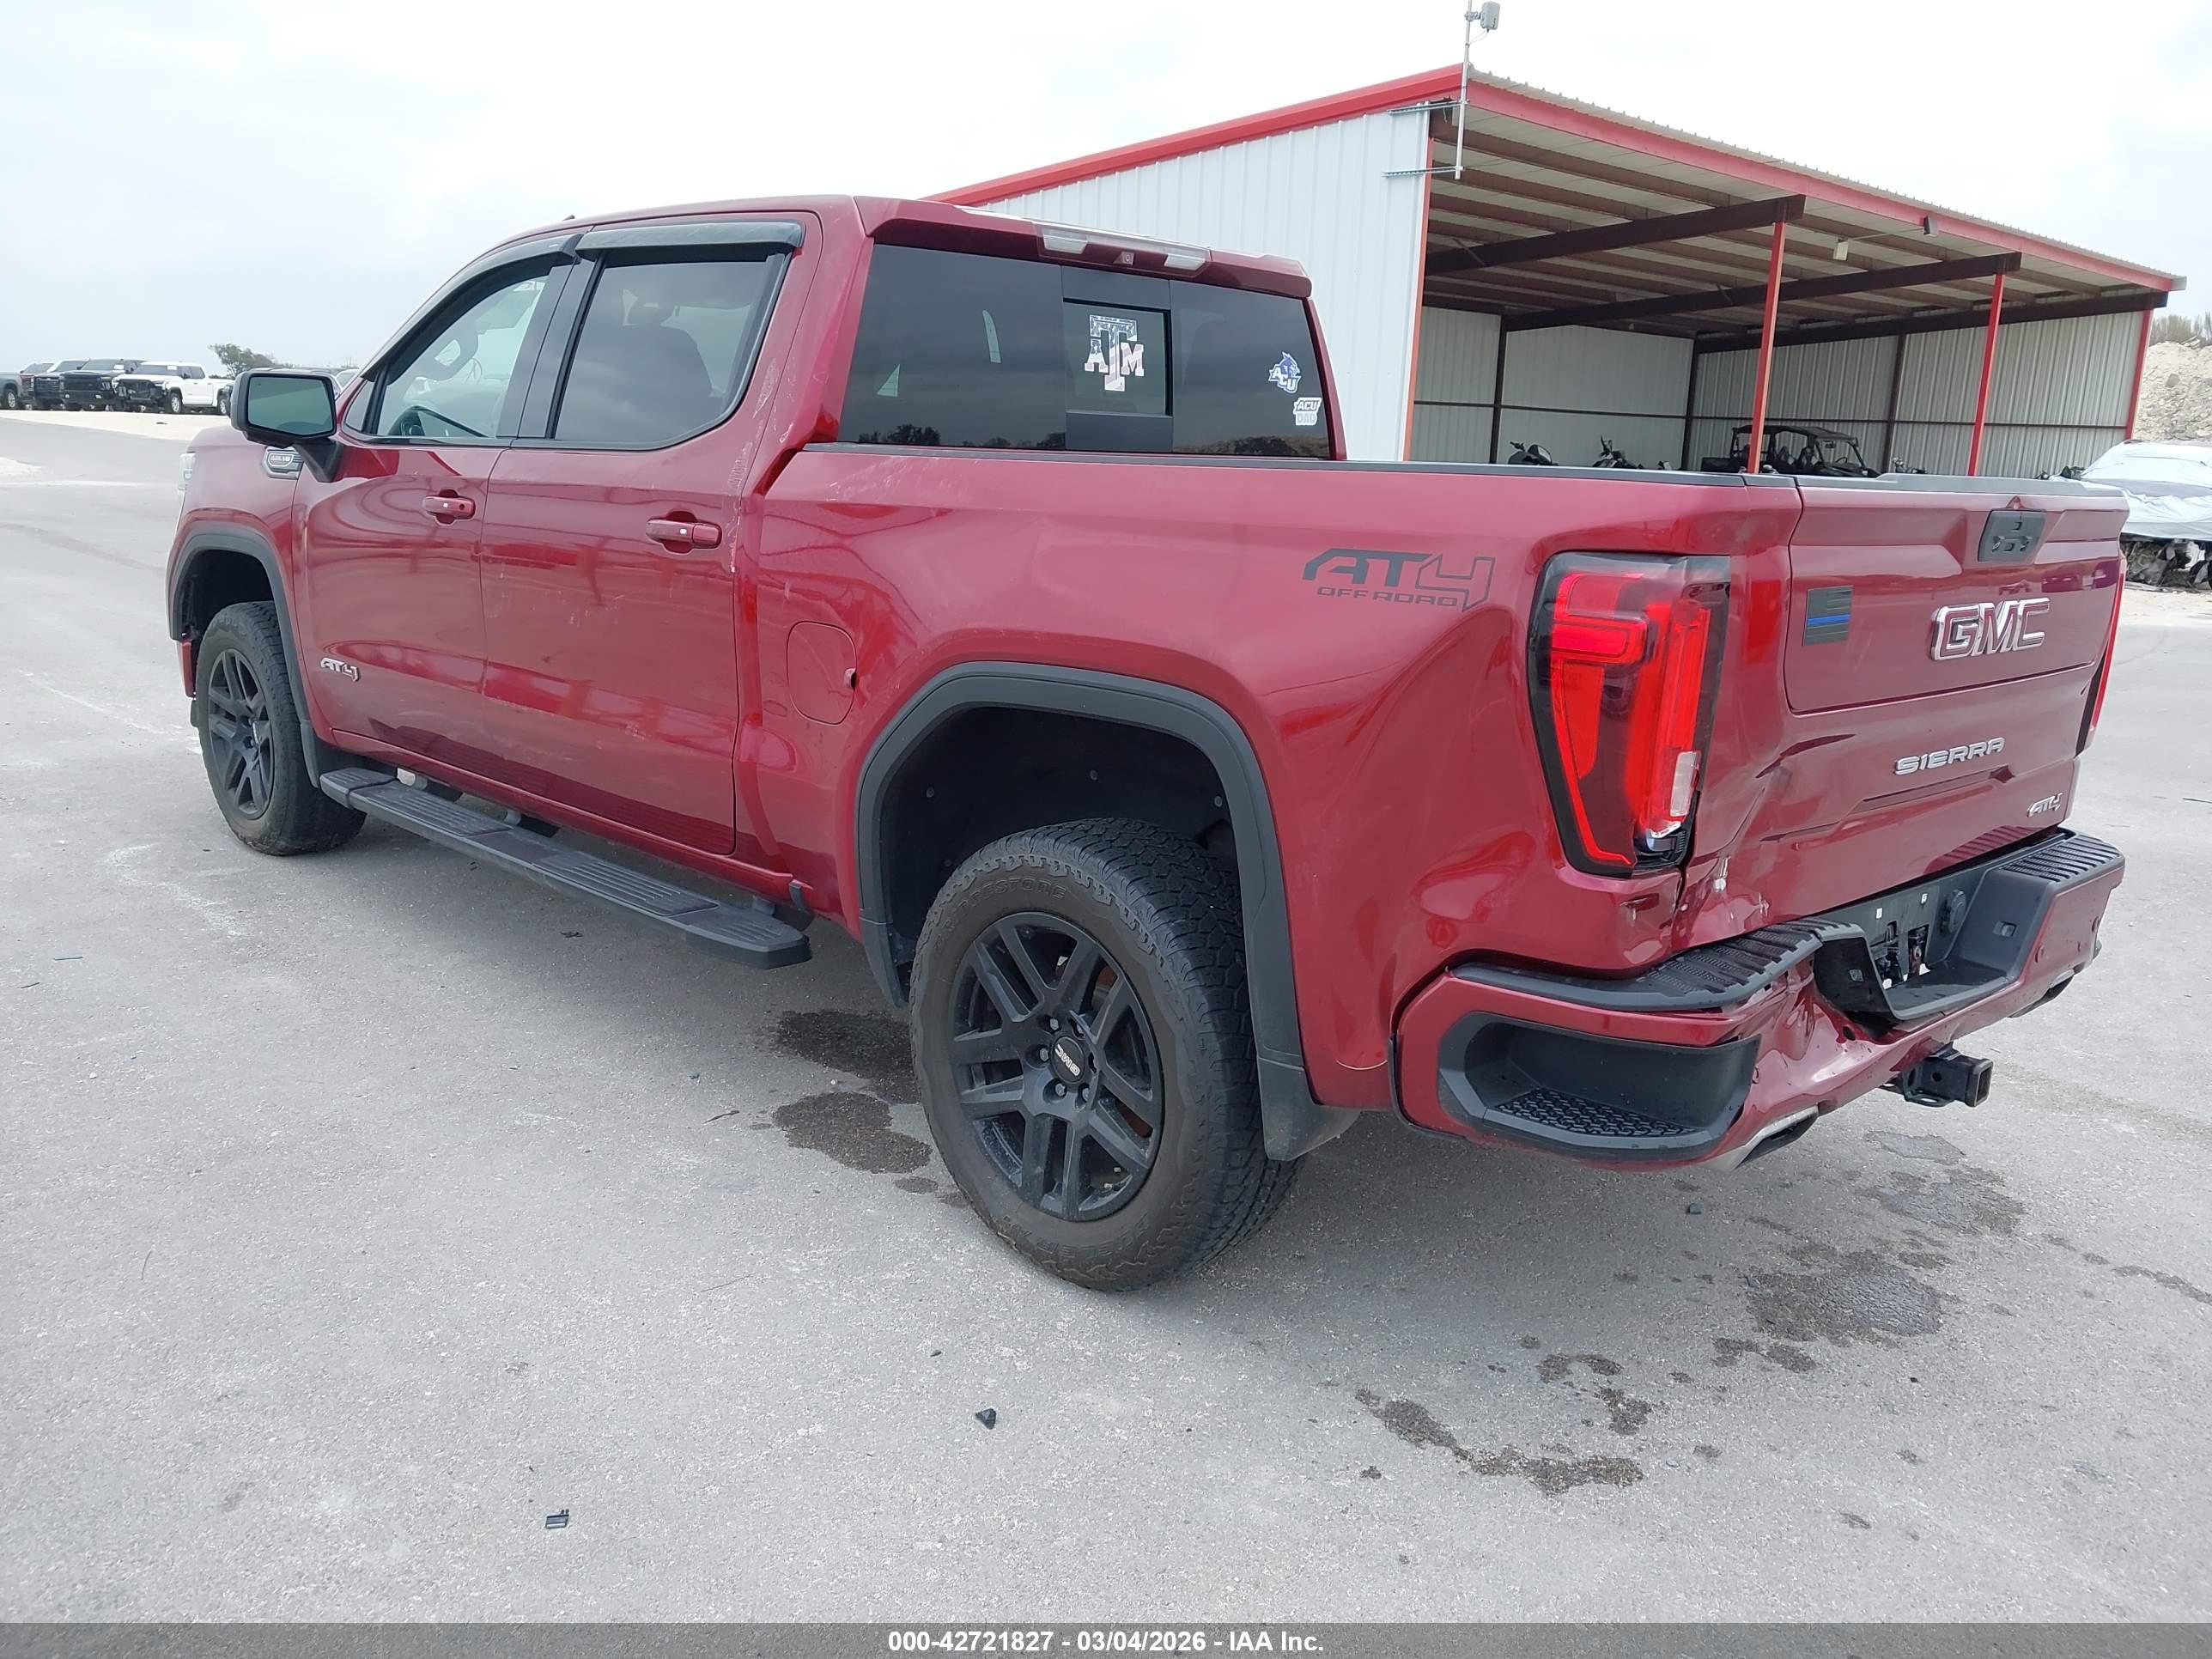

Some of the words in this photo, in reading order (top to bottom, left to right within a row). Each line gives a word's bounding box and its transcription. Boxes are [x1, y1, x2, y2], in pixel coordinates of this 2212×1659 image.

[1271, 366, 1297, 391] ACU
[1297, 400, 1317, 411] ACU
[1297, 413, 1316, 424] DAD
[1302, 548, 1496, 612] AT4
[1317, 586, 1369, 599] OFF
[1372, 591, 1459, 607] ROAD
[1931, 598, 2051, 660] GMC
[319, 657, 359, 682] AT4
[1893, 737, 2006, 775] SIERRA
[2027, 792, 2063, 817] AT4
[953, 878, 1067, 915] RESTONE
[1054, 1043, 1081, 1077] GMC
